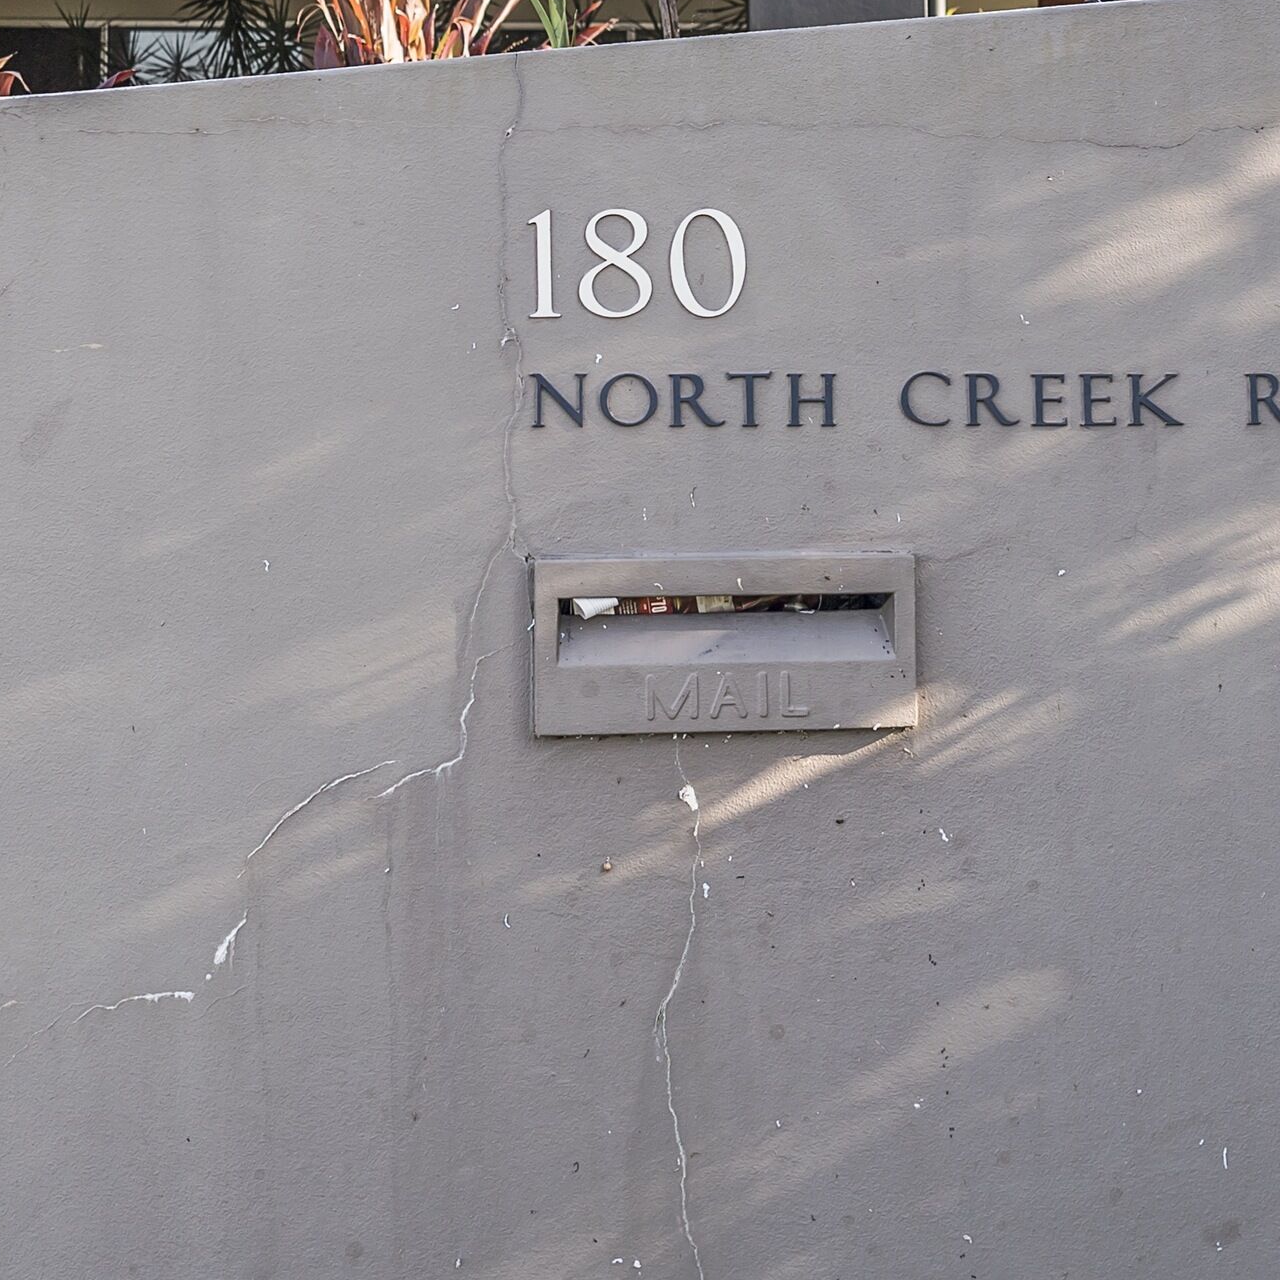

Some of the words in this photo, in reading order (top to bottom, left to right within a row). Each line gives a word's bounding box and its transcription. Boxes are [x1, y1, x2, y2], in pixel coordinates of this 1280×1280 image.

[527, 208, 748, 318] 180
[528, 370, 838, 429] NORTH
[899, 370, 1185, 429] CREEK
[644, 670, 811, 721] MAIL
